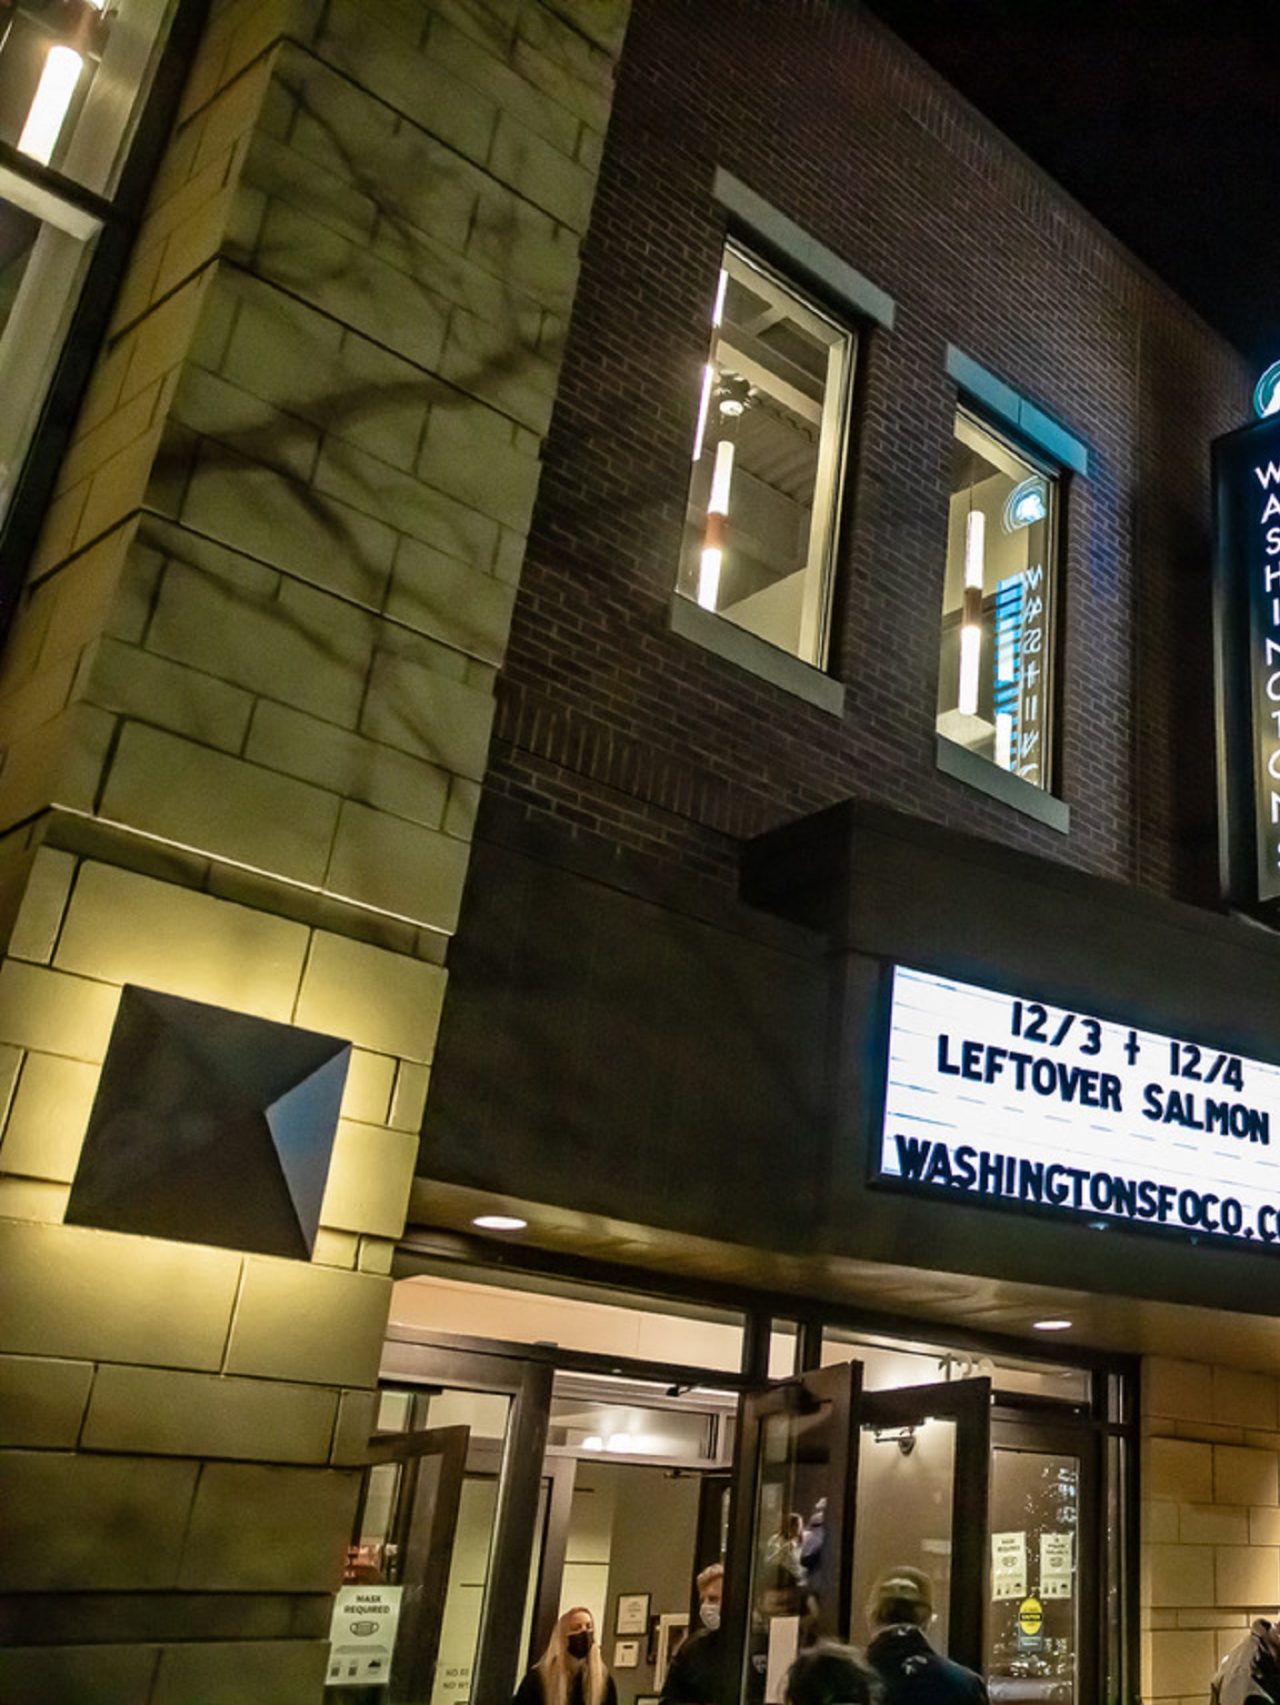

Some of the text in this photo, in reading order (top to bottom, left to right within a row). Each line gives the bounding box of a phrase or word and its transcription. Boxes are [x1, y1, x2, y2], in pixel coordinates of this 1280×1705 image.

[1011, 1001, 1101, 1055] 12/3
[1170, 1041, 1245, 1092] 12/4
[936, 1034, 1270, 1145] LEFTOVER SALMON
[343, 1605, 391, 1615] REQUIRED
[356, 1595, 381, 1603] MASK
